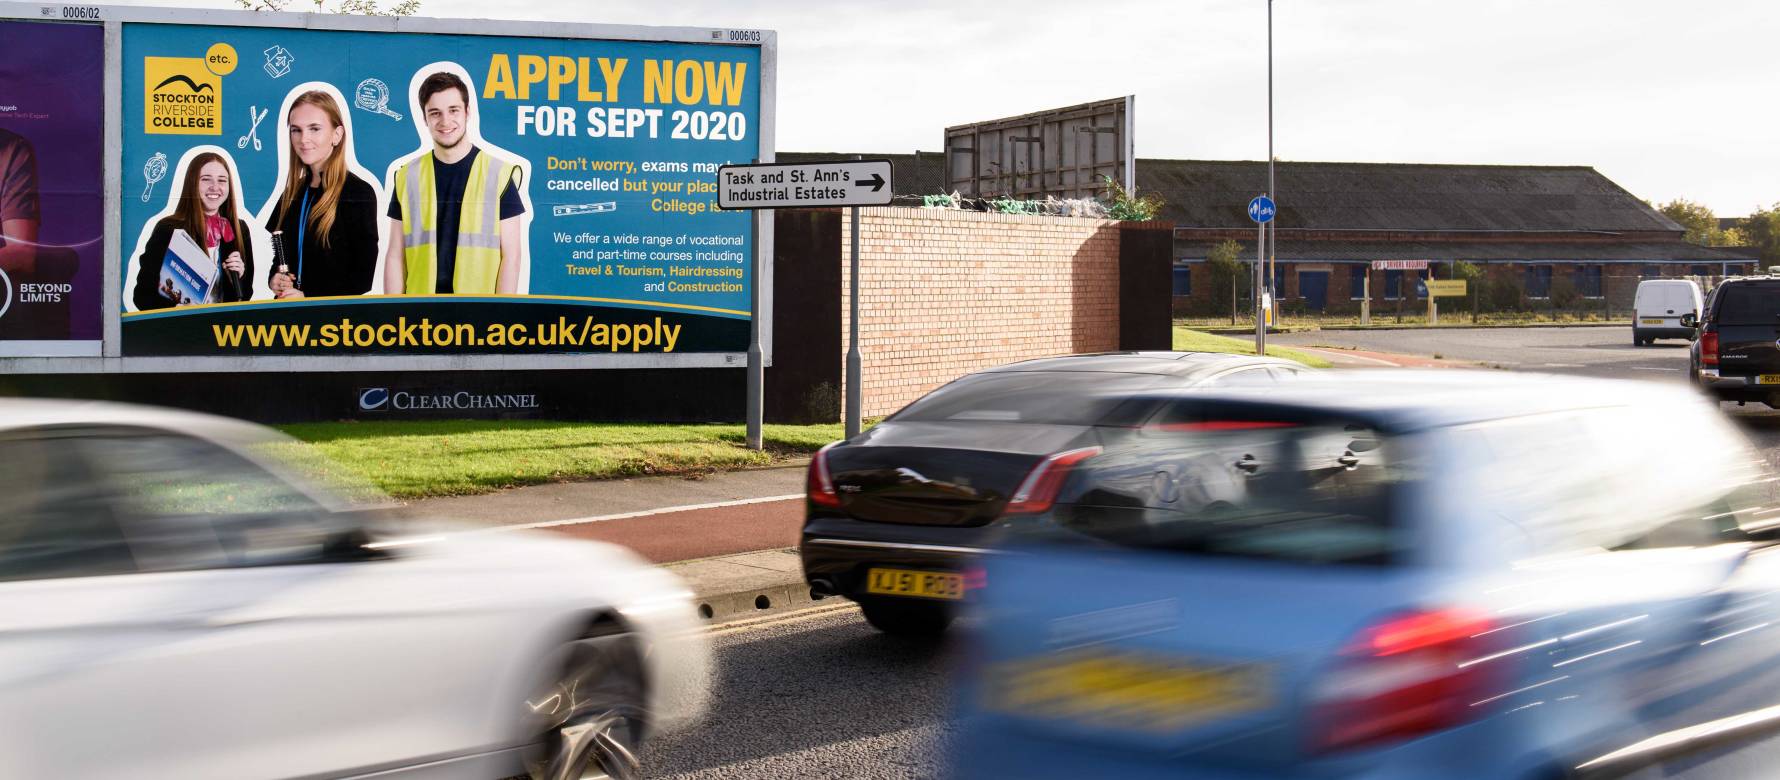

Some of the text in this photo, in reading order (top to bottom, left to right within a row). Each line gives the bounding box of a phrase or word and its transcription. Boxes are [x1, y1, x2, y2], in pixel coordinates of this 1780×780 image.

[63, 6, 100, 19] 0006/02
[730, 30, 761, 42] 0006/03
[209, 54, 231, 64] etc.
[482, 53, 748, 107] APPLY NOW
[153, 93, 214, 104] STOCKTON
[153, 104, 214, 117] RIVERSIDE
[153, 117, 214, 128] COLLEGE
[517, 105, 747, 141] FOR SEPT 2020
[547, 156, 588, 171] Don't
[591, 161, 638, 174] worry,
[641, 161, 689, 172] exams
[725, 168, 850, 185] Task and St. Ann's
[547, 178, 619, 191] cancelled
[623, 179, 648, 192] but
[651, 182, 684, 194] your
[728, 186, 846, 202] Industrial Estates
[651, 198, 706, 215] College
[553, 232, 744, 247] We offer a wide range of vocational
[572, 249, 744, 263] and part-time courses including
[566, 264, 743, 278] Travel & Tourism, Hairdressing
[20, 283, 73, 293] BEYOND
[644, 281, 743, 292] and Construction
[20, 293, 62, 302] LIMITS
[212, 316, 682, 352] www.stockton.ac.uk/apply
